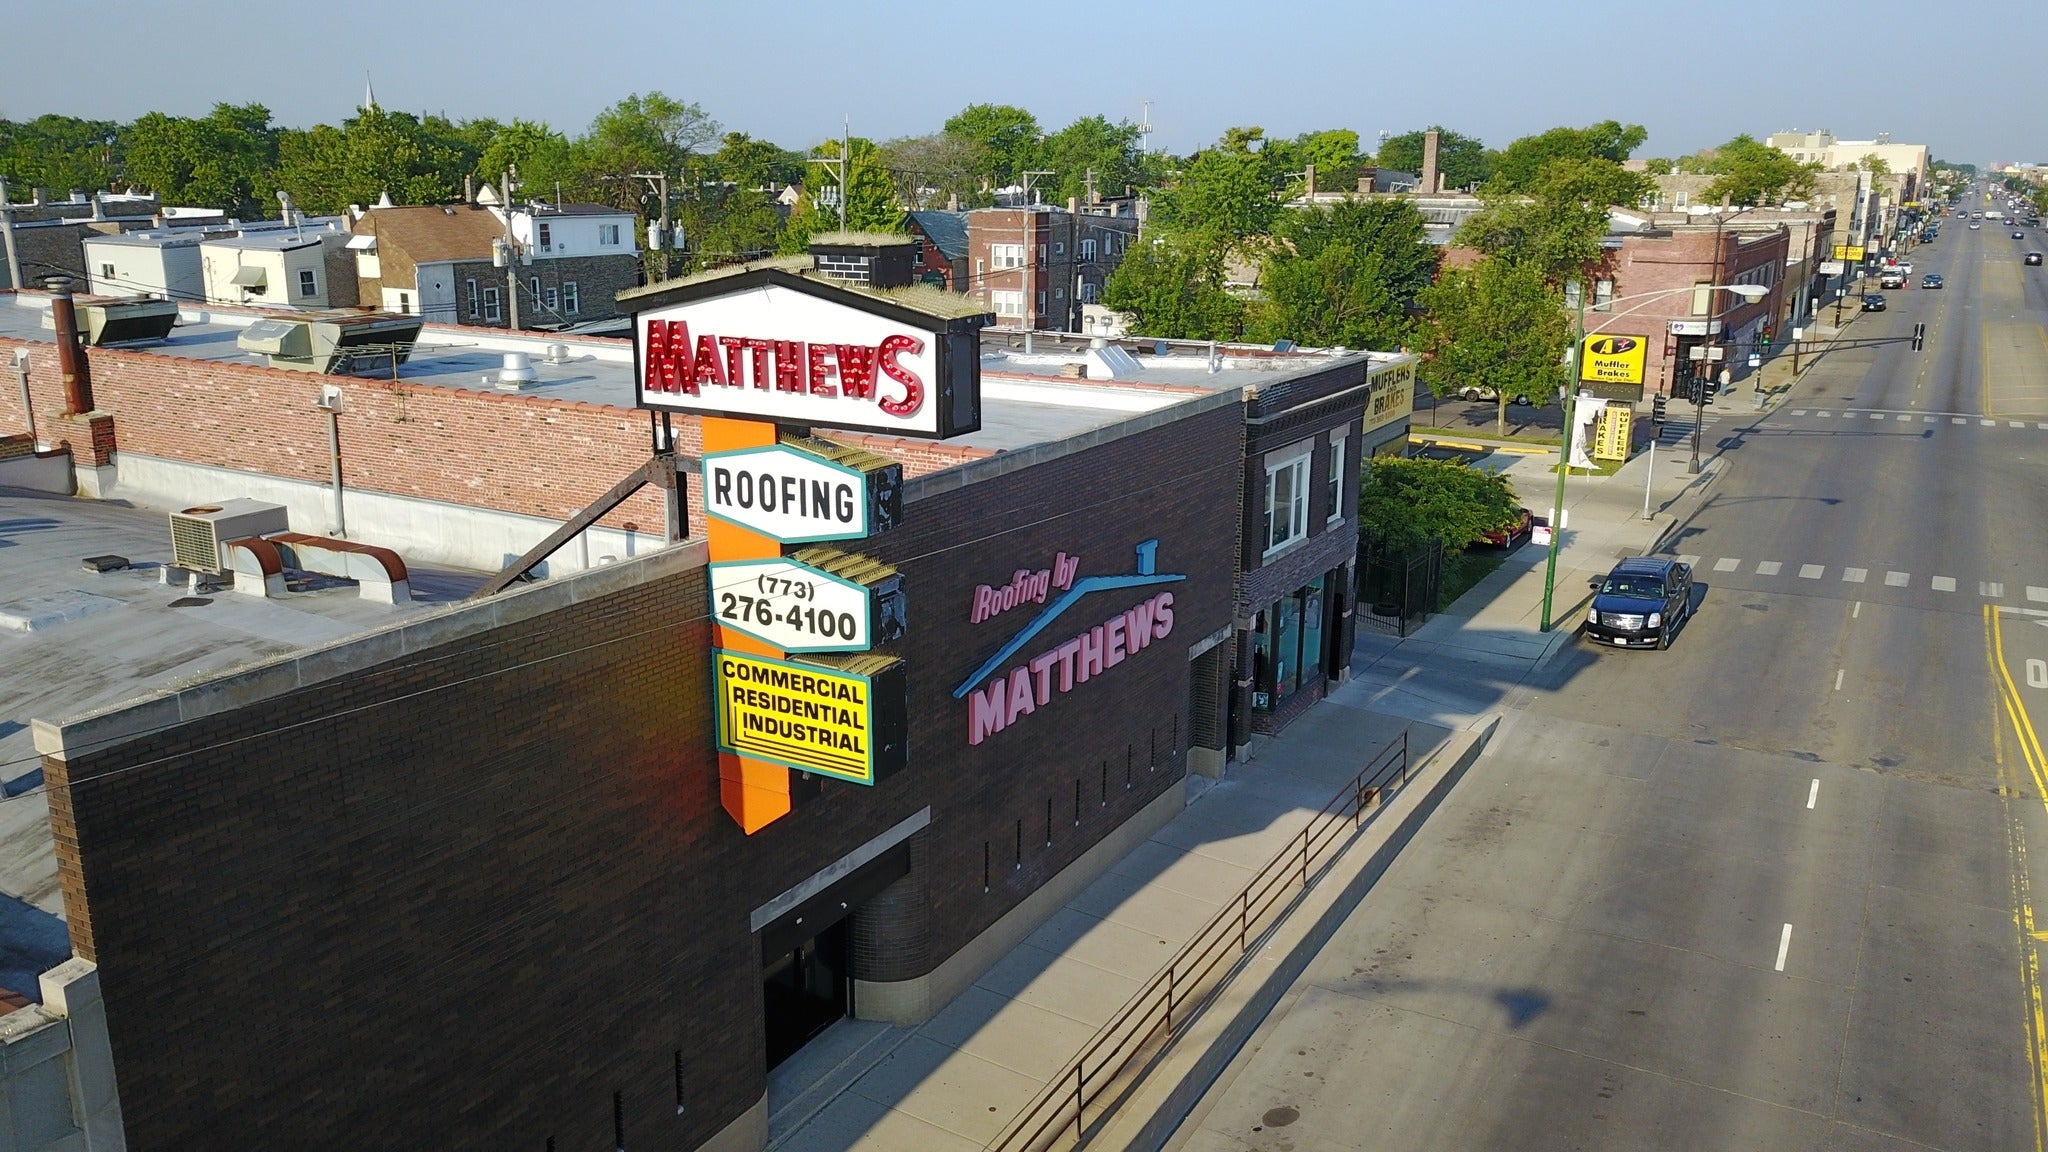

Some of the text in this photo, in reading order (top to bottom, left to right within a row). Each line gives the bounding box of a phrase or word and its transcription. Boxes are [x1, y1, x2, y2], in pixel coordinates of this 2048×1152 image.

[645, 319, 924, 415] MATTHEWS
[1371, 364, 1410, 393] MUFFLERS
[1594, 360, 1630, 369] Muffler
[1597, 369, 1630, 378] Brakes
[1374, 389, 1404, 415] BRAKES
[1616, 411, 1629, 457] MUFFLERS
[714, 467, 854, 524] ROOFING
[758, 574, 815, 602] (773)
[970, 552, 1080, 624] Roofing by
[721, 592, 857, 641] 276-4100
[723, 660, 864, 705] COMMERCIAL
[968, 591, 1174, 746] MATTHEWS
[733, 686, 864, 730] RESIDENTIAL
[743, 712, 865, 754] INDUSTRIAL
